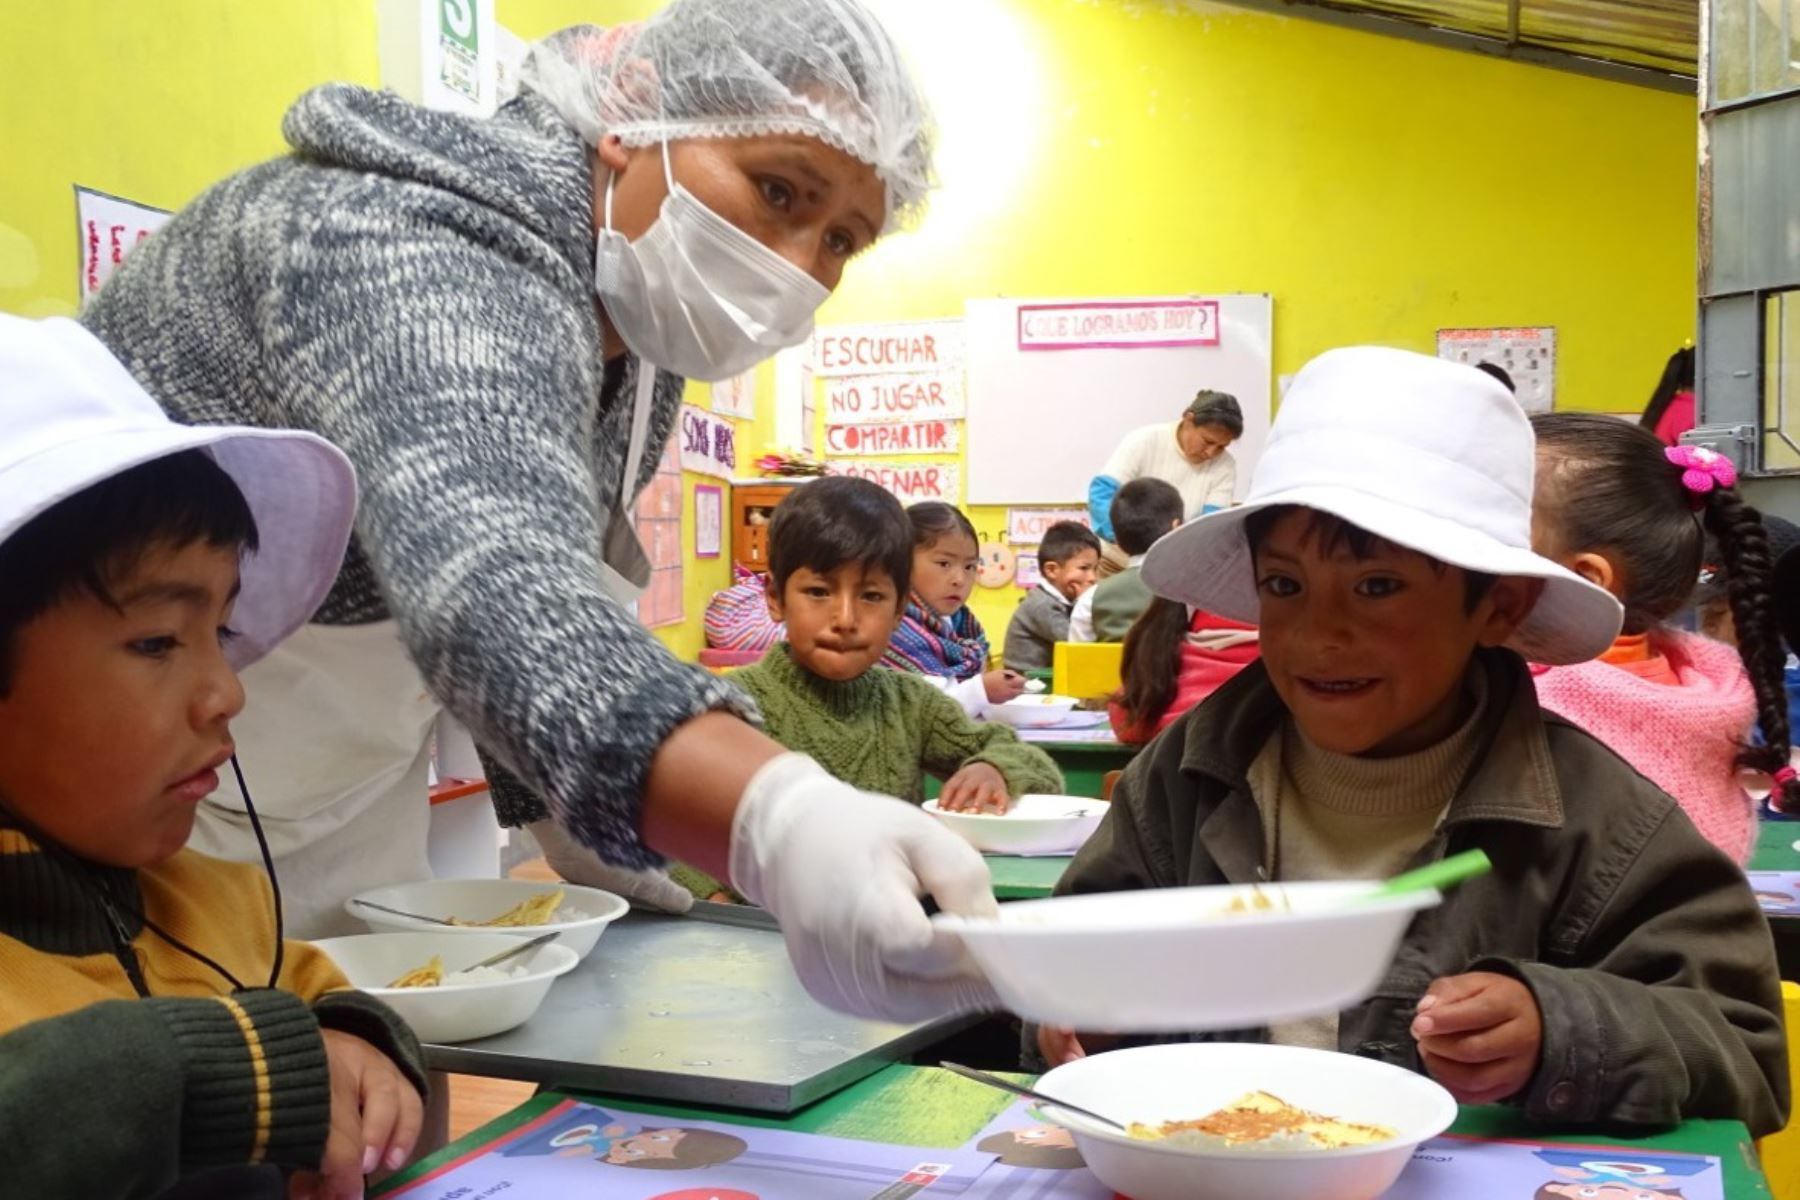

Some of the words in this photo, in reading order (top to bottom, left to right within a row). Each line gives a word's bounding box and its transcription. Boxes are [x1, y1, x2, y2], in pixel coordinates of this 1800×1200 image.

[822, 334, 938, 367] ESCUCHAR
[832, 387, 861, 412] NO
[870, 382, 946, 412] JUGAR
[827, 421, 946, 451] COMPARTIR
